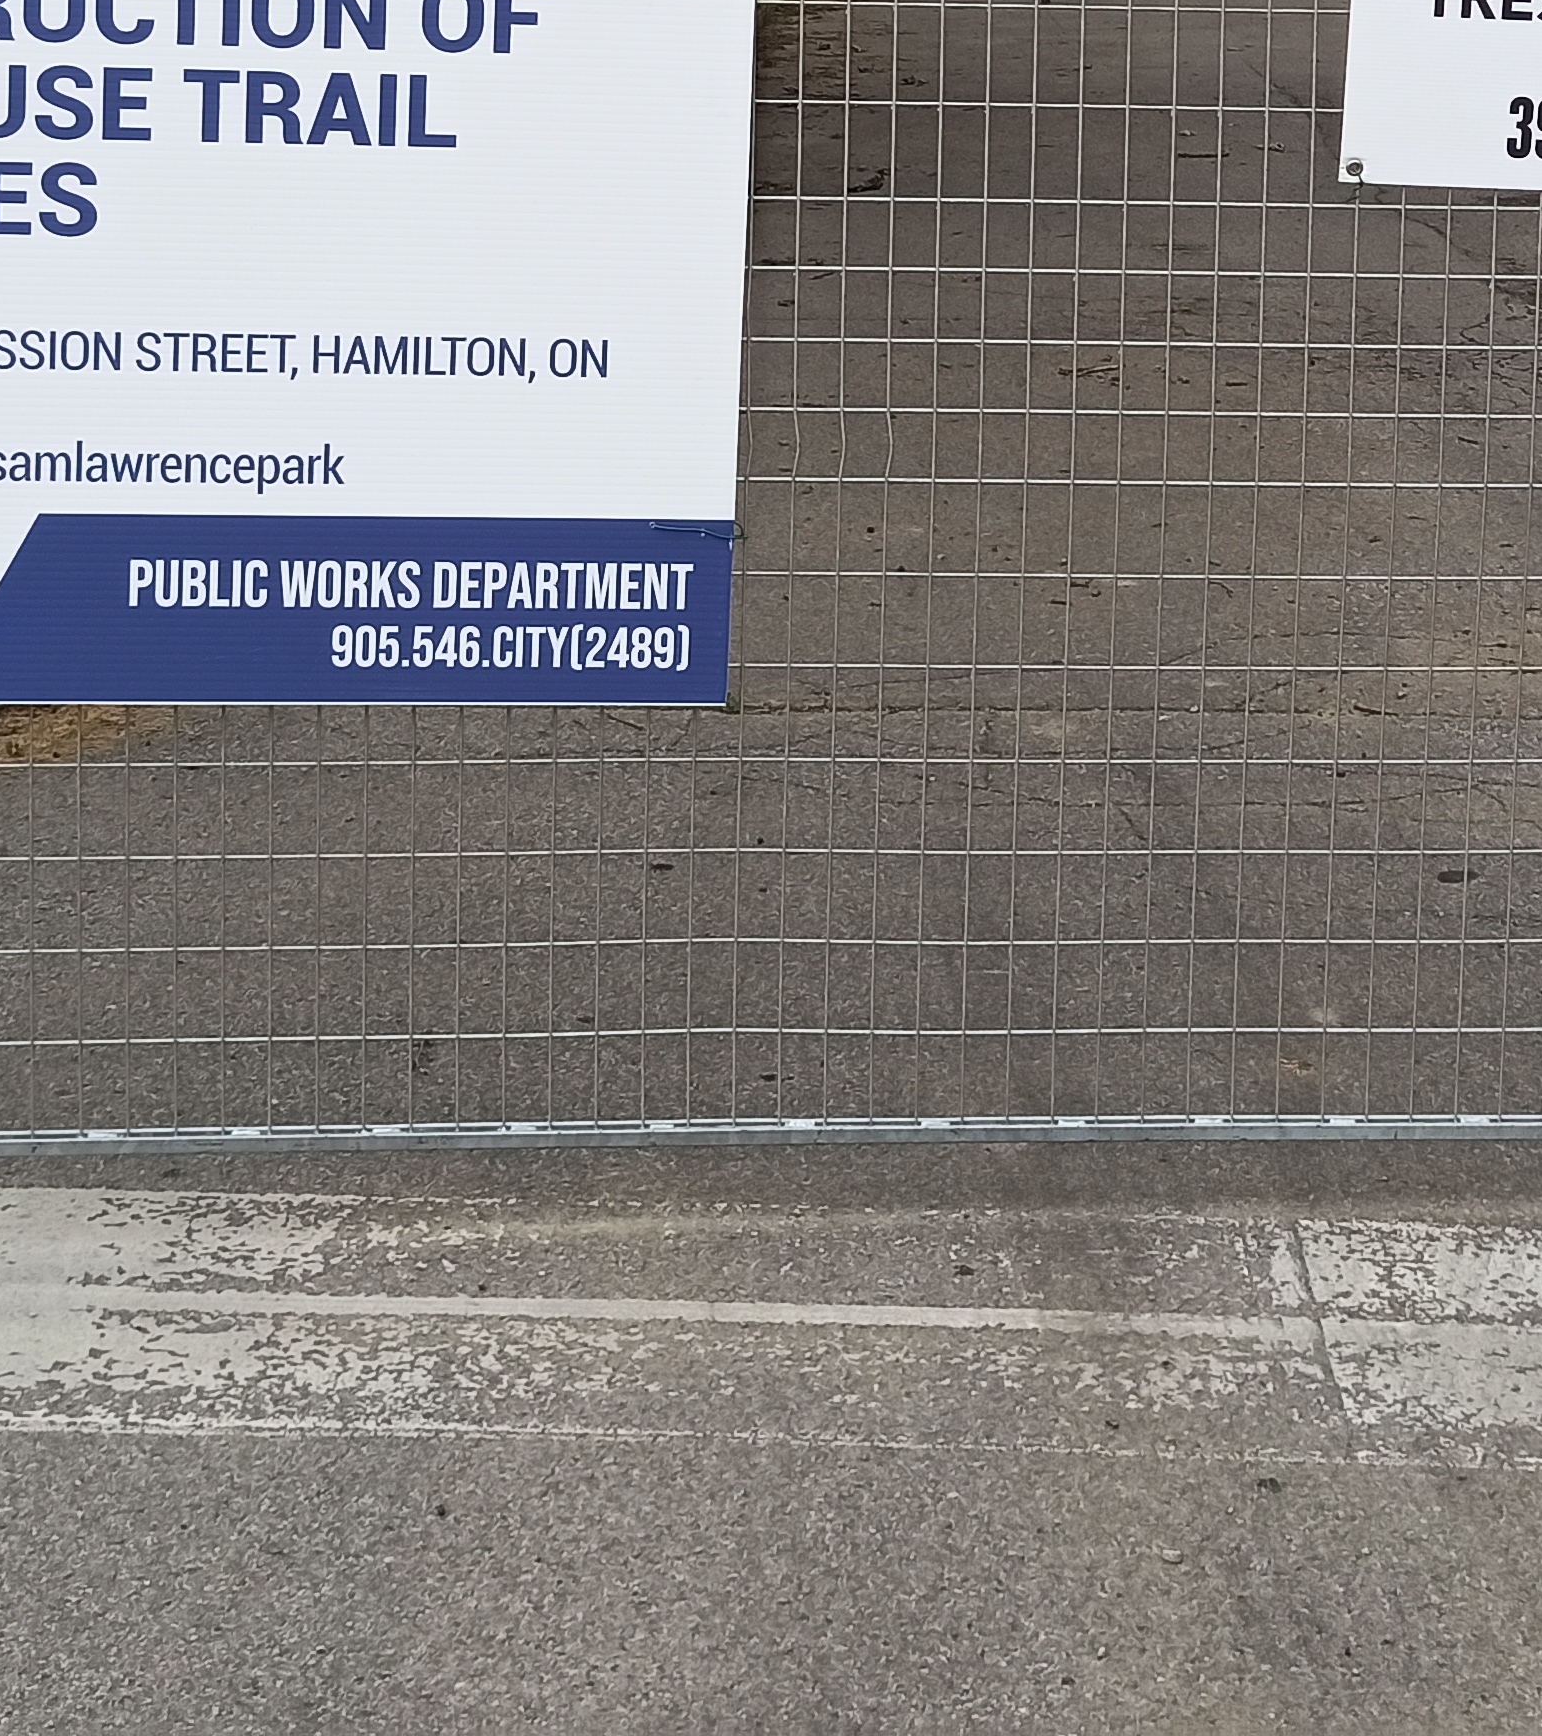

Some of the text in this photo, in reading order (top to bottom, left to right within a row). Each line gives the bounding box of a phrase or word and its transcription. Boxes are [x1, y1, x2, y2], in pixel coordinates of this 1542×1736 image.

[184, 69, 456, 147] TRAIL
[136, 332, 298, 380] STREET,
[313, 335, 535, 383] HAMILTON,
[550, 339, 608, 377] ON
[129, 560, 693, 609] PUBLIC WORKS DEPARTMENT
[332, 624, 689, 671] 905.546.CITY(2489)
